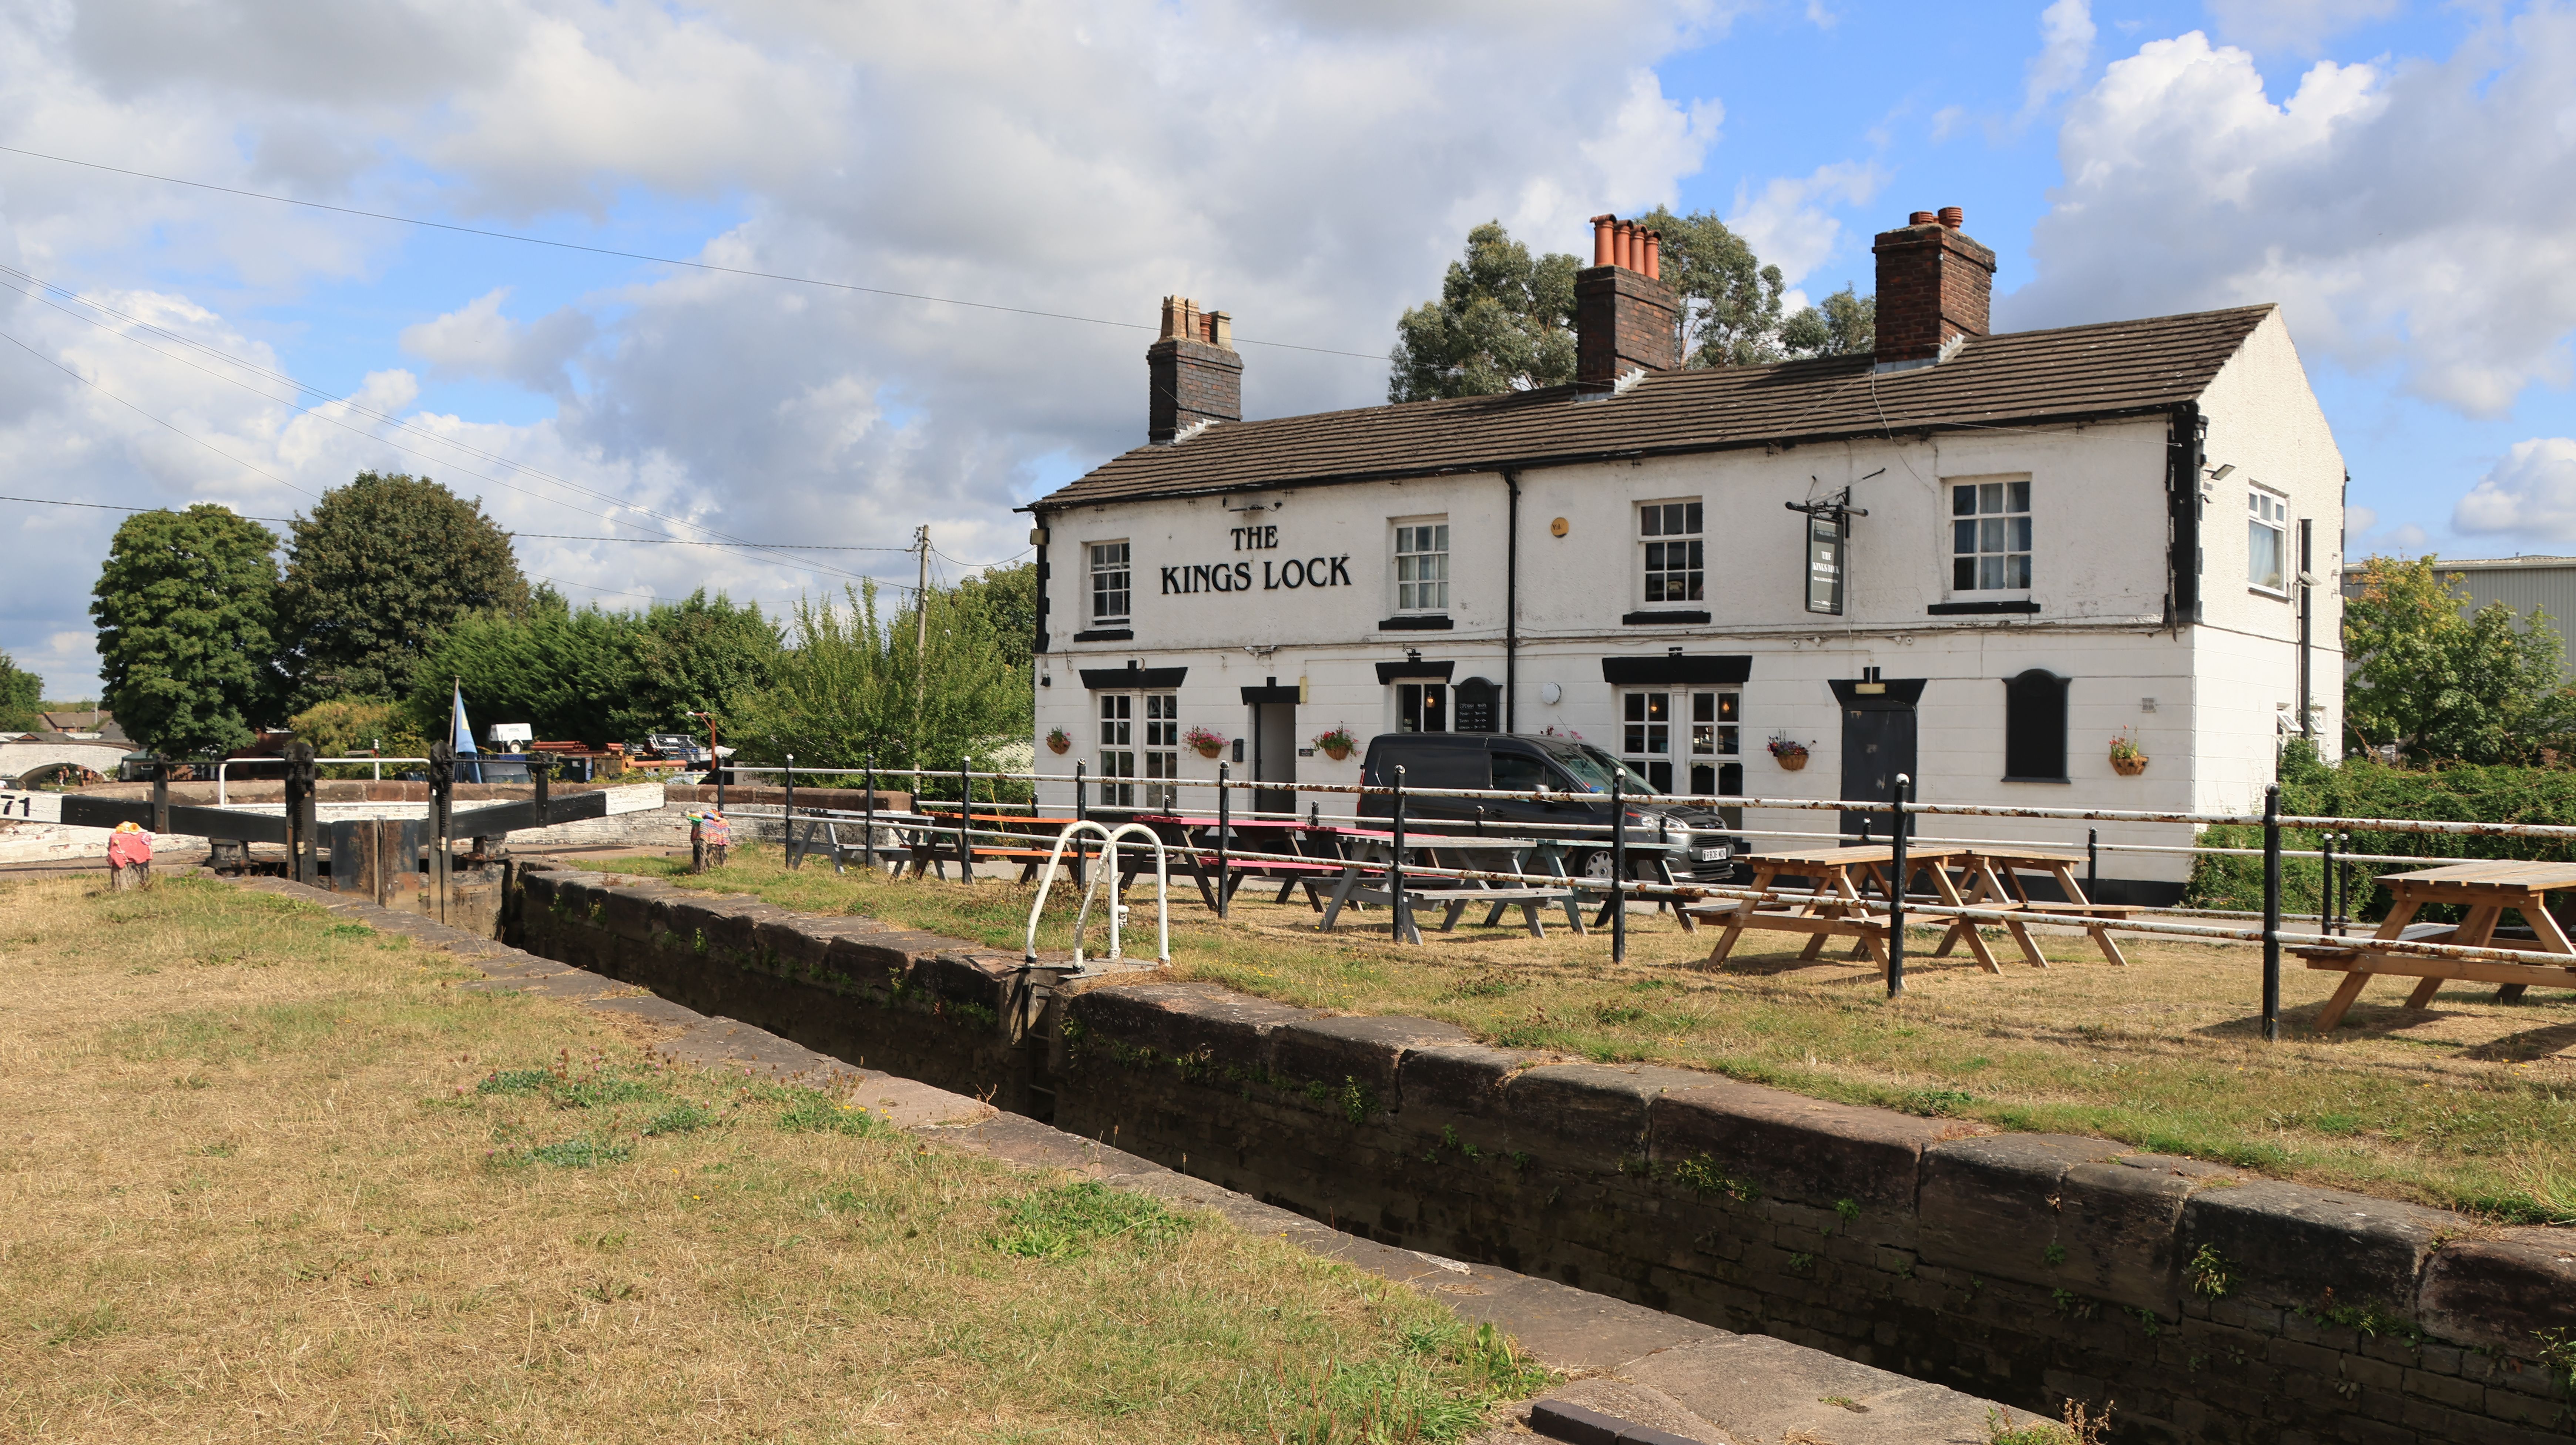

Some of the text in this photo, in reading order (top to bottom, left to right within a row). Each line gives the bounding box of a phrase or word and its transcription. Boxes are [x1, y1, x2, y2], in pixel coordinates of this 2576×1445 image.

[1230, 525, 1278, 551] THE
[1821, 551, 1832, 561] THE
[1161, 556, 1352, 594] KINGS LOCK
[1812, 561, 1839, 574] KINGS LOCK
[1, 795, 31, 817] 71
